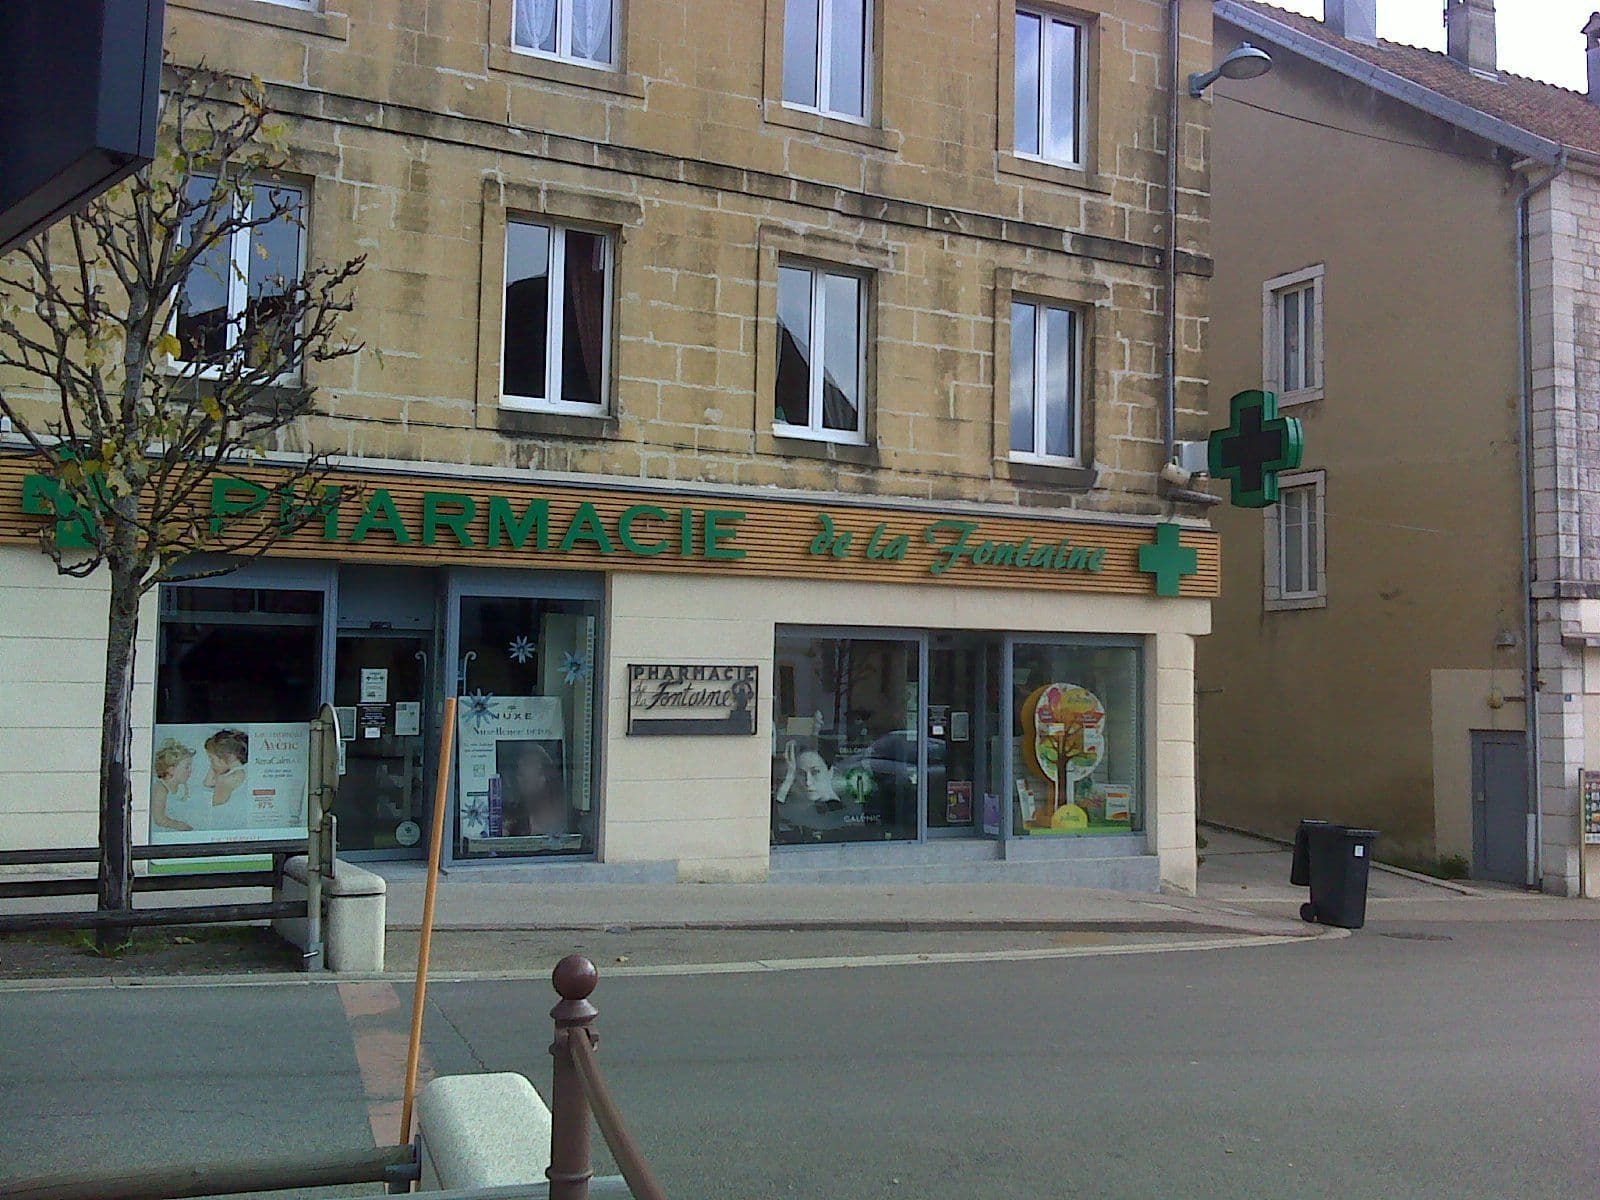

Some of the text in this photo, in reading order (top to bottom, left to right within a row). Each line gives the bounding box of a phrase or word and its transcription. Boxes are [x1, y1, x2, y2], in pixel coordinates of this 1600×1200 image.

[211, 477, 1106, 575] PHARMACIE de la Fontaine
[634, 666, 755, 682] PHARMACIE
[645, 680, 732, 710] Fontaine
[491, 712, 533, 720] NUXE
